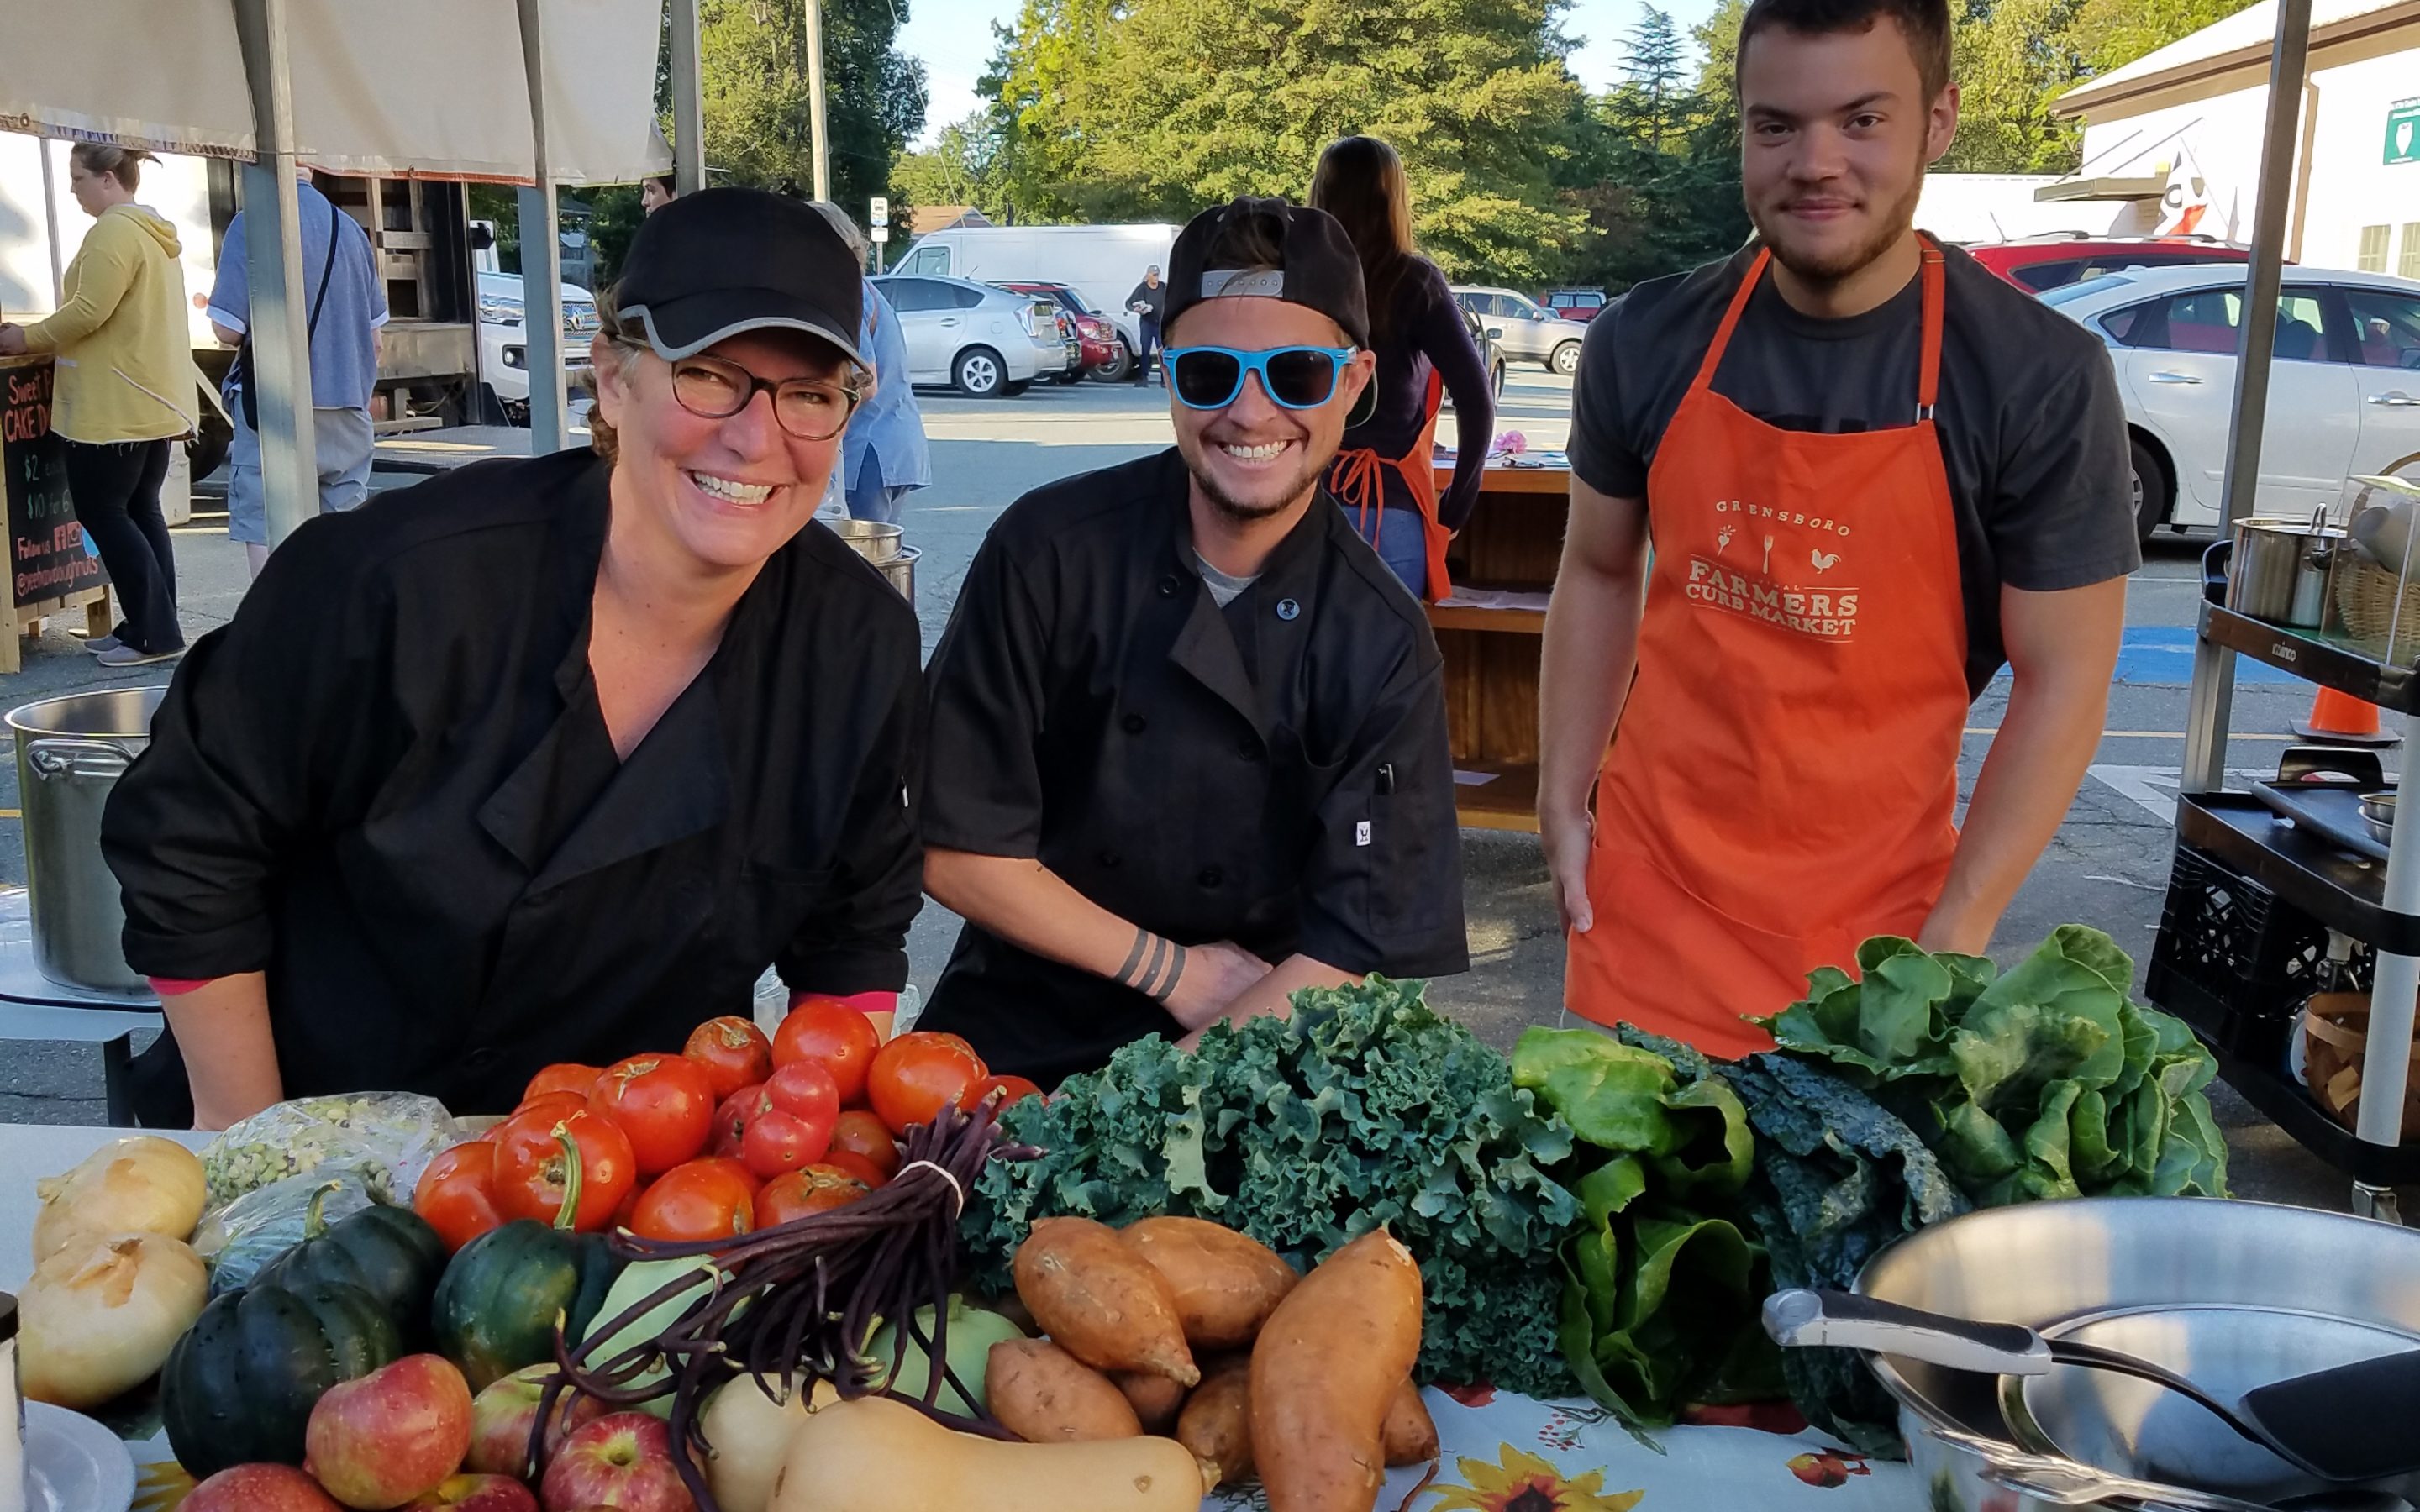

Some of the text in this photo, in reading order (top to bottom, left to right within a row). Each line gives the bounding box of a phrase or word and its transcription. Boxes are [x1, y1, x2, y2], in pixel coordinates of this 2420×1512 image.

[8, 370, 40, 405] Sweet
[4, 407, 37, 443] CAKE
[24, 454, 39, 482] $2
[27, 493, 45, 519] $10
[62, 488, 71, 513] 6
[1689, 559, 1859, 617] FARMERS
[1686, 583, 1856, 636] CURB MARKET
